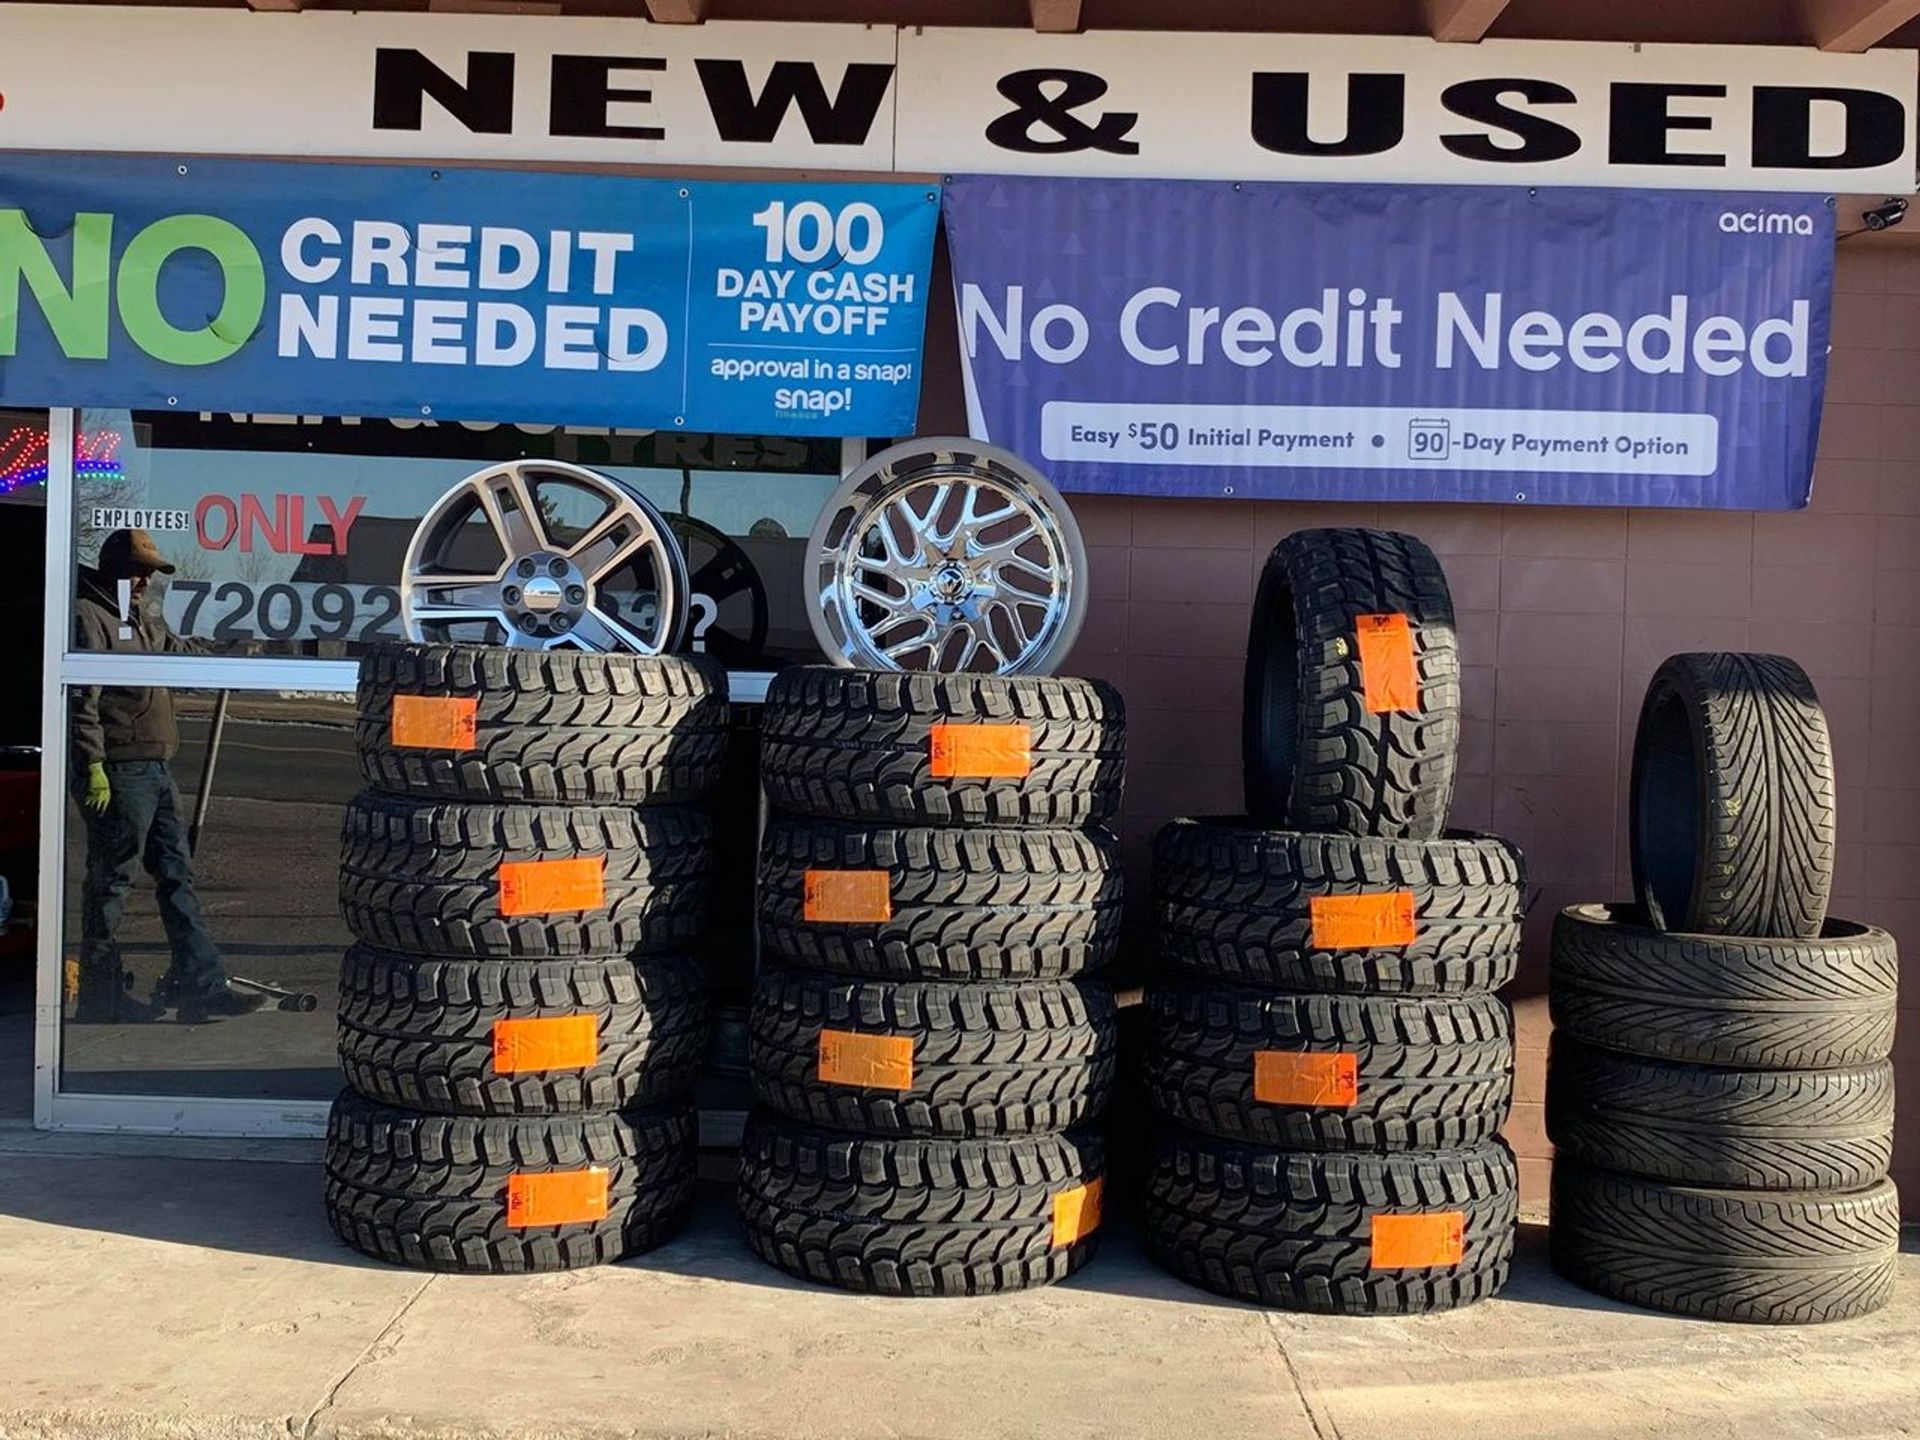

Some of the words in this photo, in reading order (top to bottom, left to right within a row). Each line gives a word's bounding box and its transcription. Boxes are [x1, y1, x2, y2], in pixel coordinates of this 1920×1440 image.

[372, 47, 896, 146] NEW
[985, 68, 1140, 156] &
[1251, 71, 1906, 170] USED
[753, 200, 884, 265] 100
[1718, 210, 1814, 236] acima
[280, 216, 634, 295] CREDIT
[0, 207, 266, 366] NO
[716, 268, 795, 299] DAY
[807, 271, 915, 303] CASH
[278, 294, 669, 372] NEEDED
[740, 301, 889, 336] PAYOFF
[961, 283, 1090, 364] No
[1119, 287, 1402, 368] Credit
[1436, 291, 1810, 378] Needed
[711, 358, 809, 381] approval
[814, 360, 832, 379] in
[837, 363, 850, 380] a
[854, 363, 912, 385] snap!
[774, 387, 851, 416] snap!
[1070, 425, 1120, 448] Easy
[1128, 422, 1179, 450] $50
[1188, 428, 1251, 447] Initial
[1258, 429, 1354, 451] Payment
[1512, 433, 1609, 457] Payment
[1614, 436, 1690, 459] Option
[94, 509, 189, 529] EMPLOYEES!
[194, 493, 367, 556] ONLY
